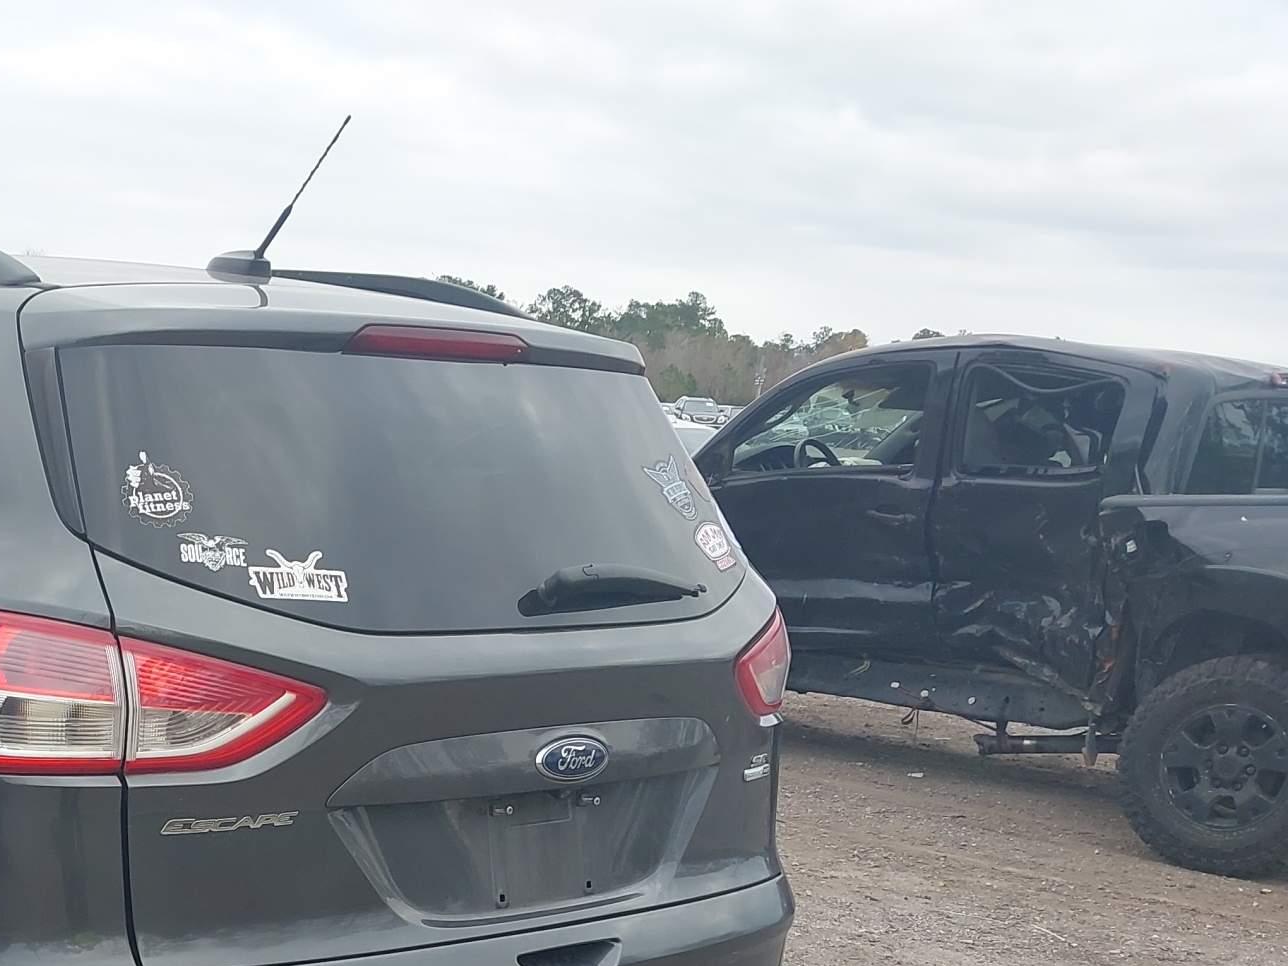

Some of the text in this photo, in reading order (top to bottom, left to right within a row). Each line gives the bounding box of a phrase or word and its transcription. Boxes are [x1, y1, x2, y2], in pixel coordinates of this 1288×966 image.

[254, 570, 344, 598] WILD WEST
[558, 745, 596, 771] Ford
[160, 810, 299, 834] ESCAPE
